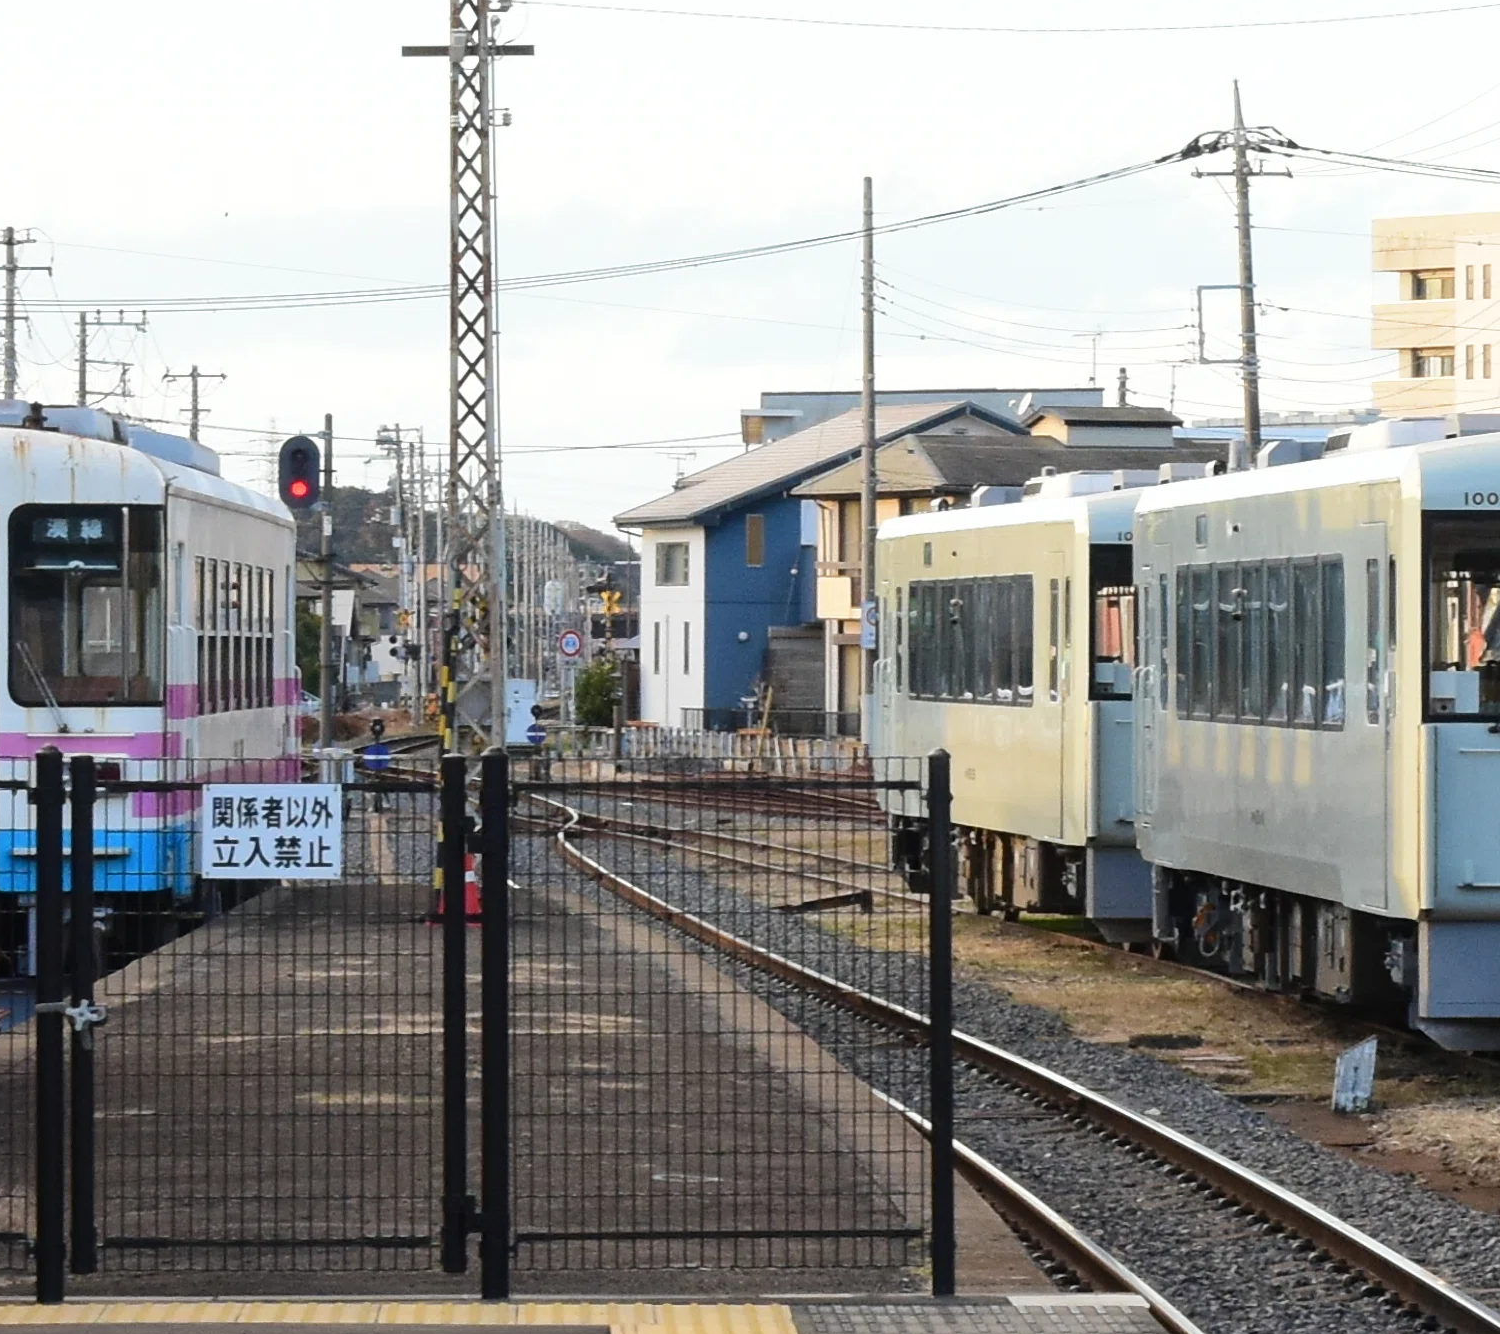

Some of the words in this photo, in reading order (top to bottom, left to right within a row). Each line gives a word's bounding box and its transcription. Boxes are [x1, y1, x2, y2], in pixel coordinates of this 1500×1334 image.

[211, 796, 334, 829] 関係者以外
[211, 835, 334, 869] 立入禁止
